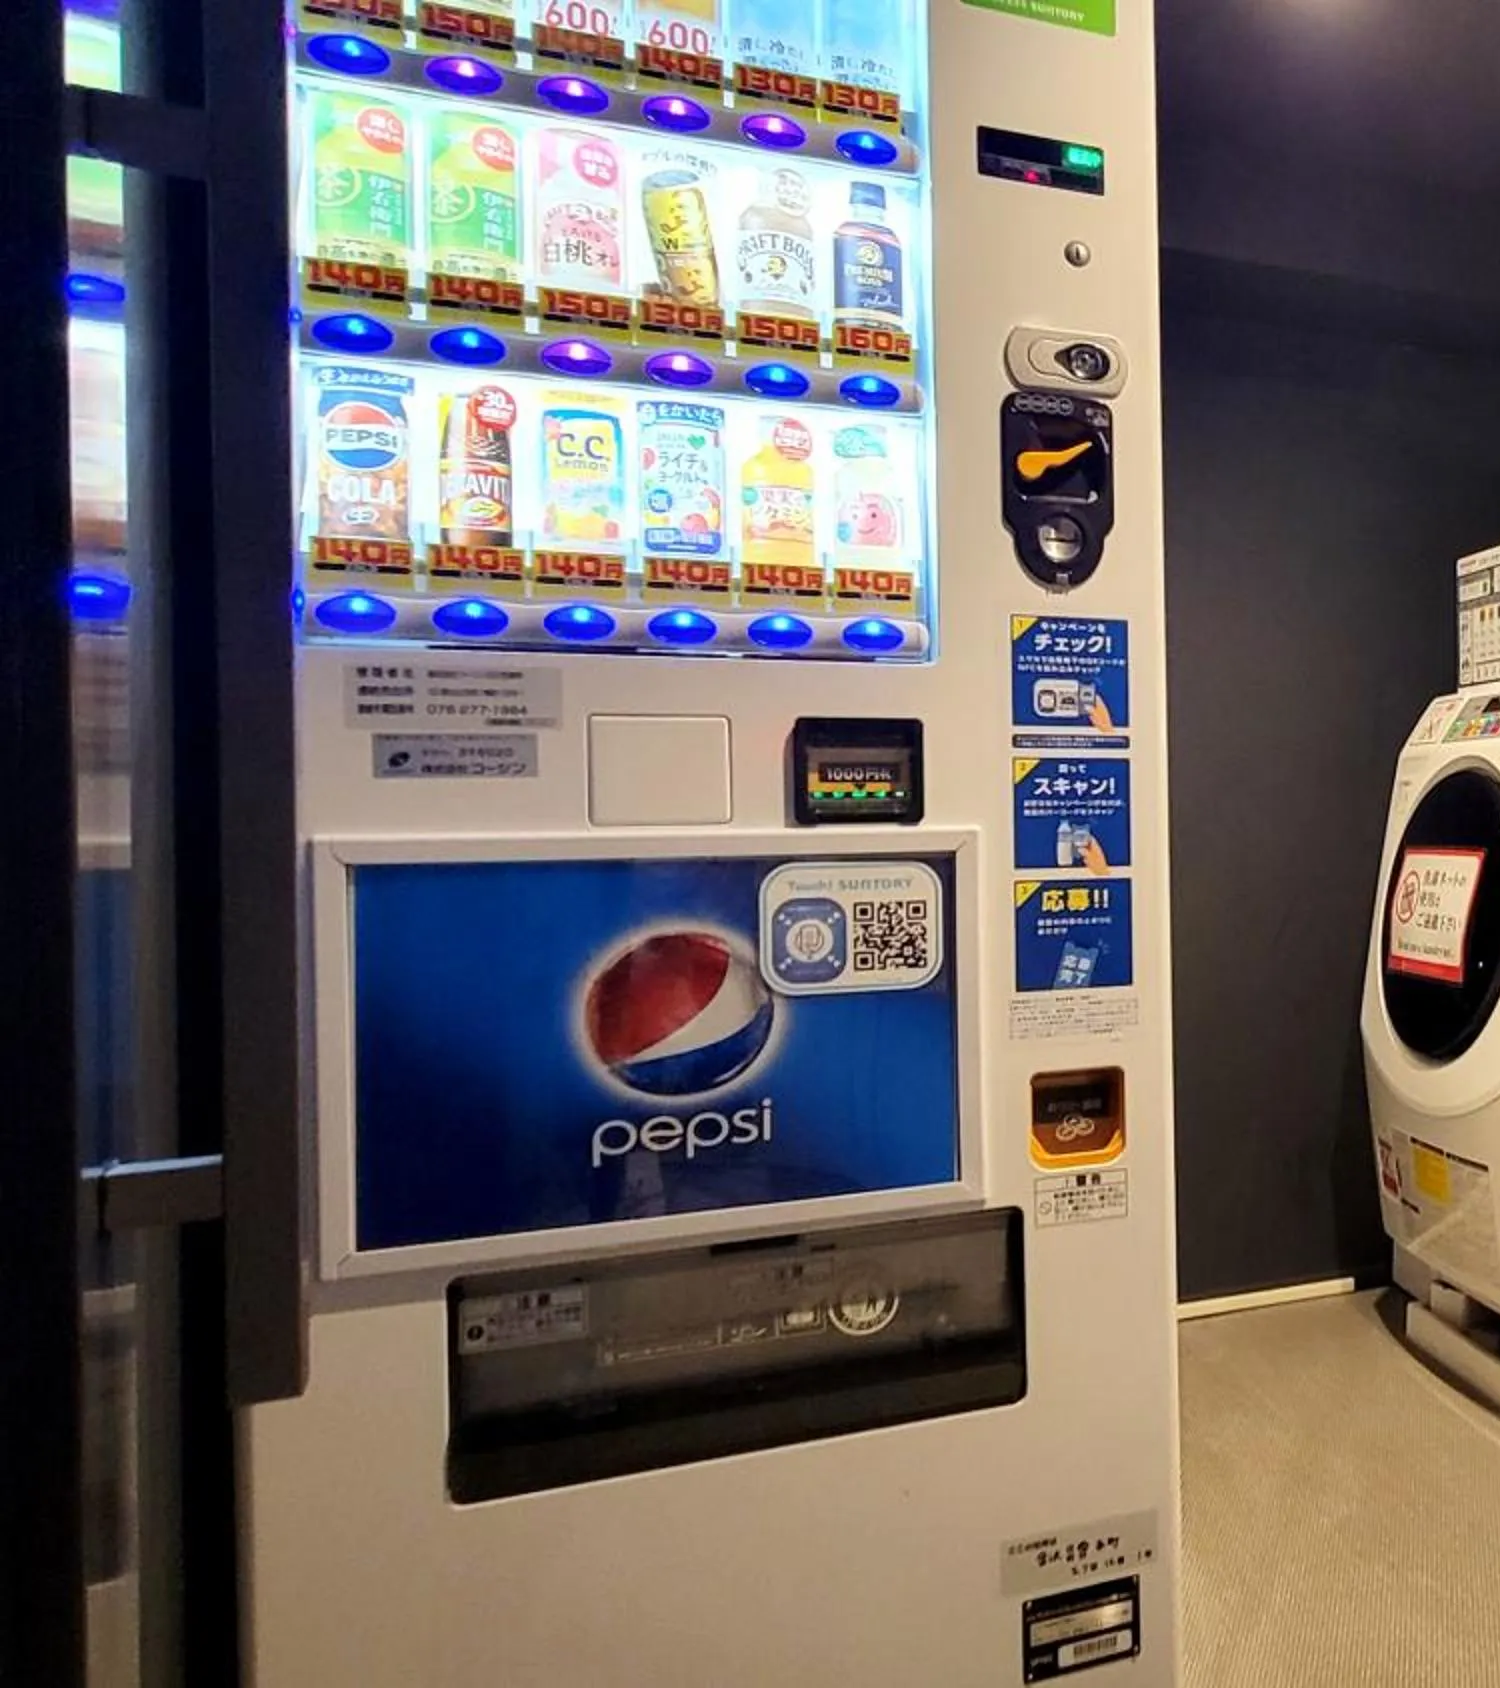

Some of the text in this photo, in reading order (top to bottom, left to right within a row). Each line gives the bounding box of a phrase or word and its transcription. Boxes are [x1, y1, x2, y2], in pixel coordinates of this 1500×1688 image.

[640, 46, 722, 81] 140円
[738, 65, 816, 101] 130円
[825, 83, 898, 115] 130円
[309, 260, 406, 291] 140円
[431, 275, 522, 307] 140円
[542, 291, 629, 319] 150円
[642, 301, 723, 331] 130円
[741, 316, 819, 345] 150円
[837, 327, 910, 354] 160円
[325, 429, 398, 448] PEPSI
[557, 433, 611, 462] C.C.
[554, 457, 608, 473] Lemon
[328, 475, 395, 503] COLA
[315, 541, 411, 567] 140円
[433, 548, 523, 573] 140円
[538, 554, 623, 578] 140円
[652, 561, 729, 585] 140円
[746, 566, 824, 589] 140円
[838, 572, 913, 594] 140円
[1034, 634, 1111, 654] チェック!
[1033, 777, 1115, 795] スキャン!
[838, 879, 913, 890] SUNTORY
[592, 1098, 772, 1168] pepsi
